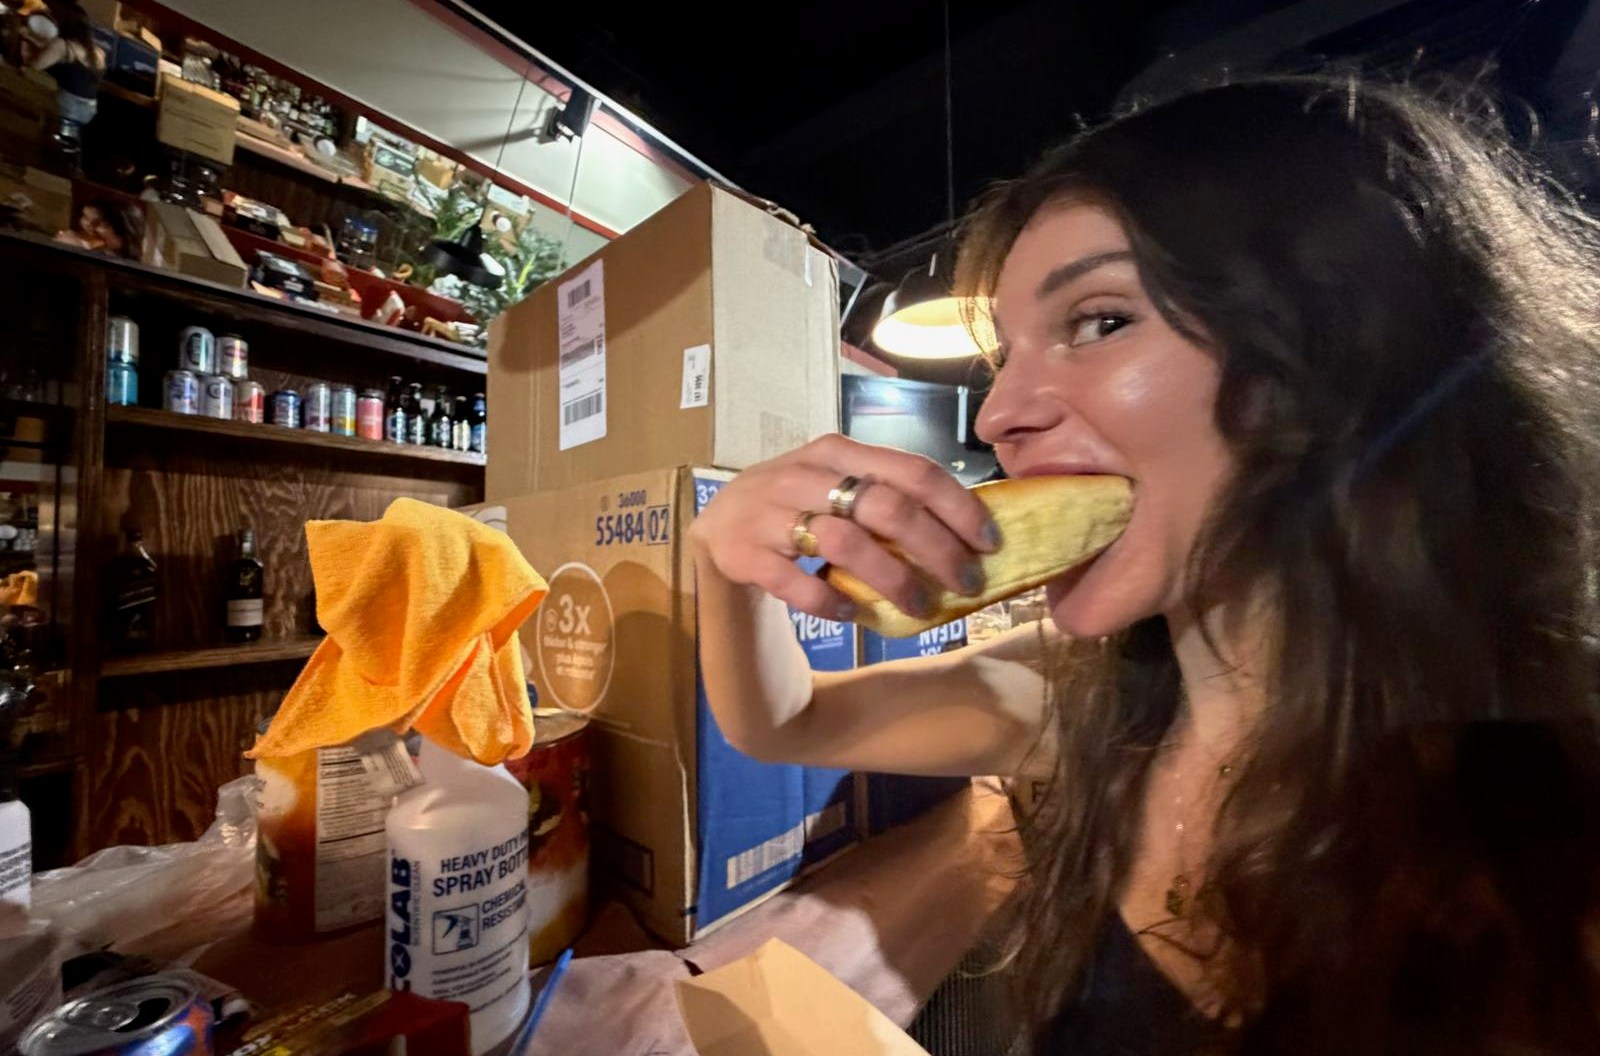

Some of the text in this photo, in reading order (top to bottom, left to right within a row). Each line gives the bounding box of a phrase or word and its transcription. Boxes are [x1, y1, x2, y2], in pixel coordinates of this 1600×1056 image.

[595, 508, 669, 546] 55484 02
[440, 849, 489, 874] HEAVY
[492, 836, 519, 860] DUTY
[432, 865, 495, 898] SPRAY
[390, 857, 411, 992] COLAB
